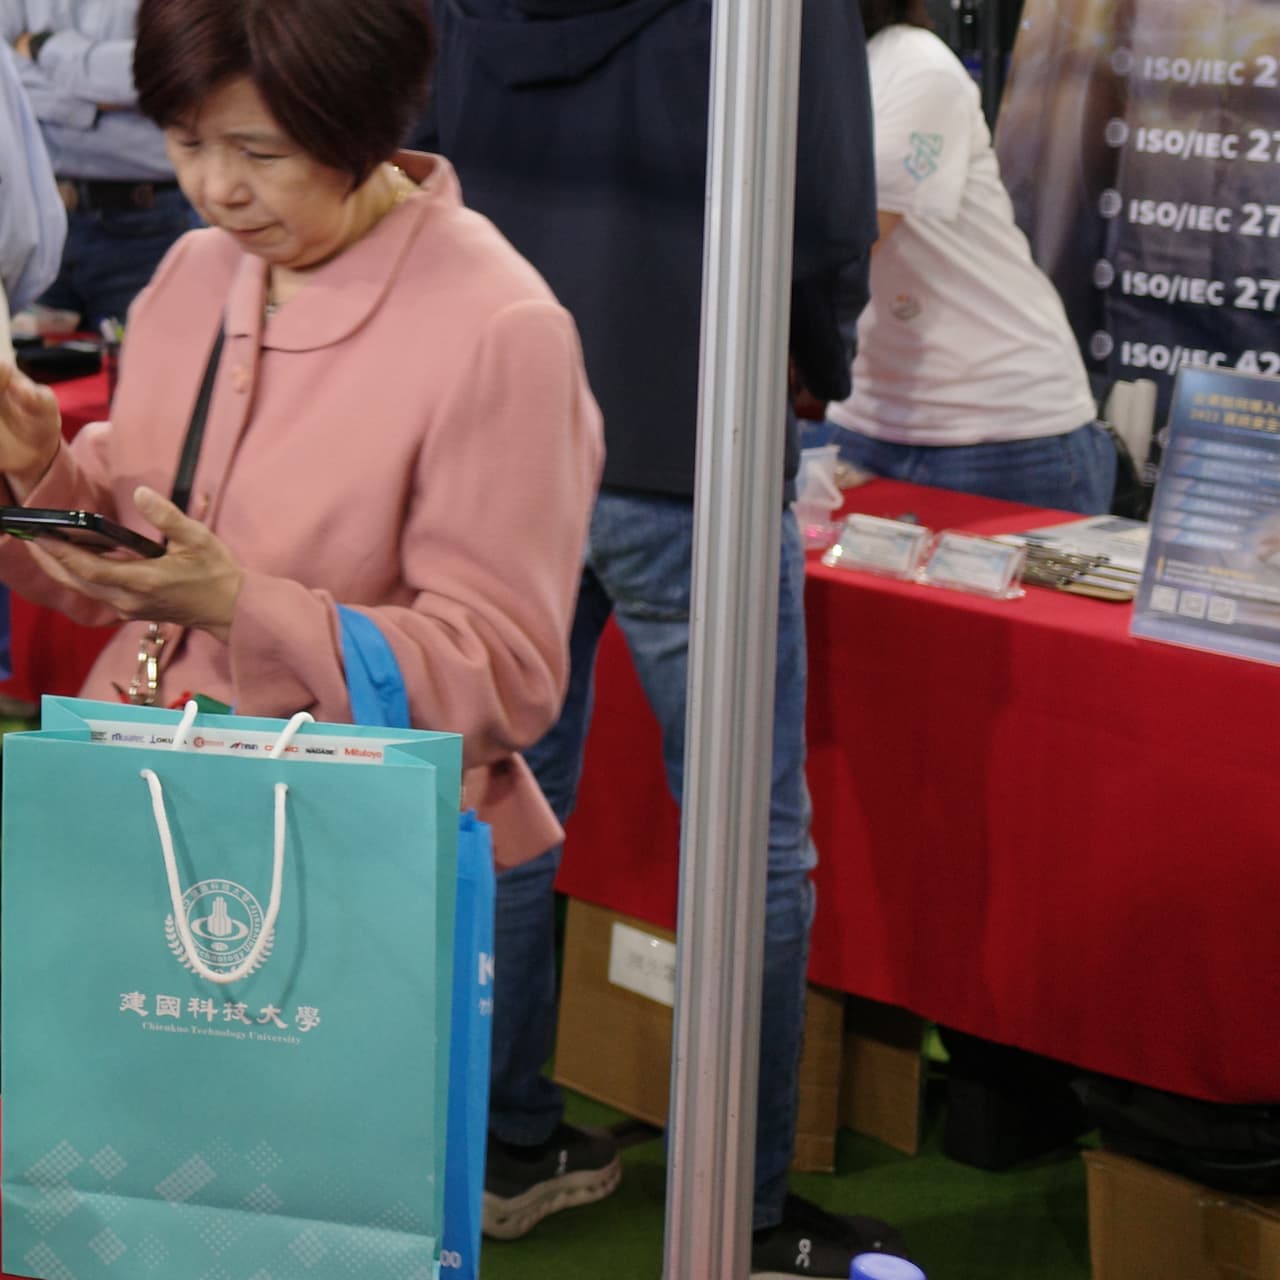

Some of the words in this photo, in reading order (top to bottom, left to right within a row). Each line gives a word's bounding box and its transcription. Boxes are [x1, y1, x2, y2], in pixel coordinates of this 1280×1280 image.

[1143, 54, 1246, 87] ISO/IEC
[1135, 126, 1240, 160] ISO/IEC
[1128, 198, 1233, 234] ISO/IEC
[1121, 269, 1225, 306] ISO/IEC
[119, 991, 321, 1033] 建國科技大學
[191, 1026, 246, 1040] Technology
[249, 1031, 302, 1045] University
